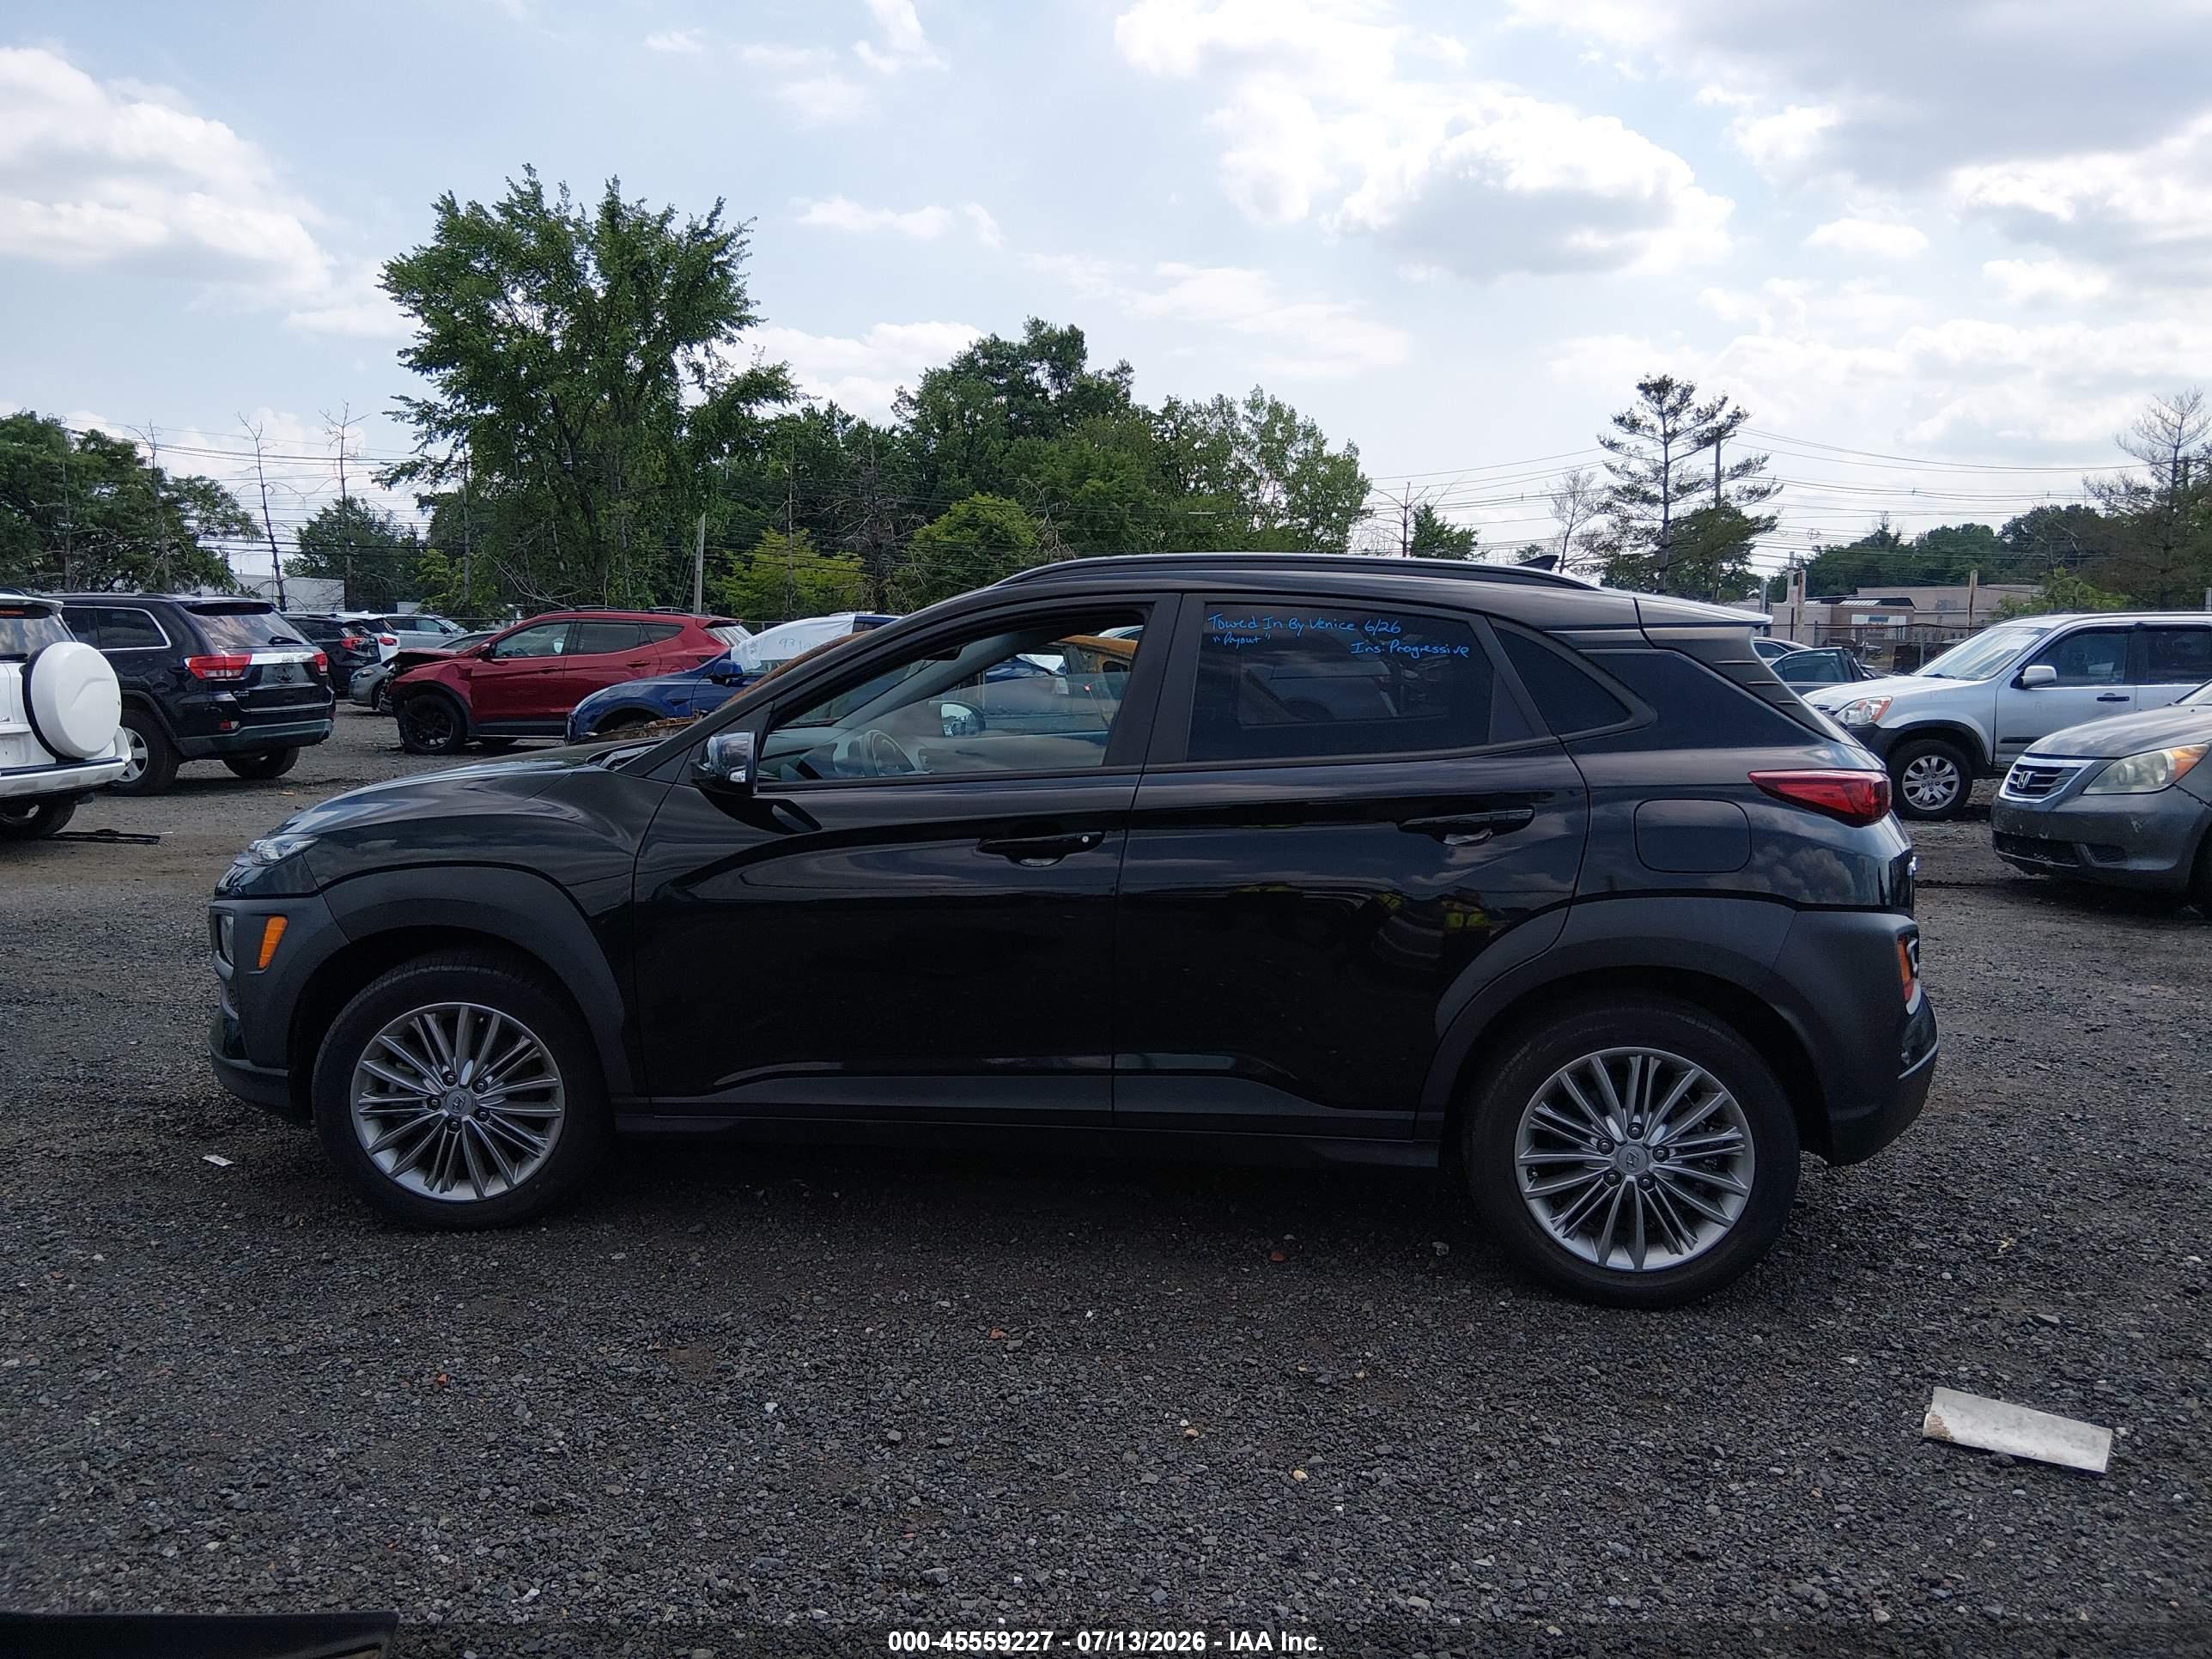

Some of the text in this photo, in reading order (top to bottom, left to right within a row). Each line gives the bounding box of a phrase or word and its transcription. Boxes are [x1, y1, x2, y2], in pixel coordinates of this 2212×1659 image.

[1208, 613, 1401, 637] Towed In By Venice 6/26
[1389, 639, 1469, 659] Progressive
